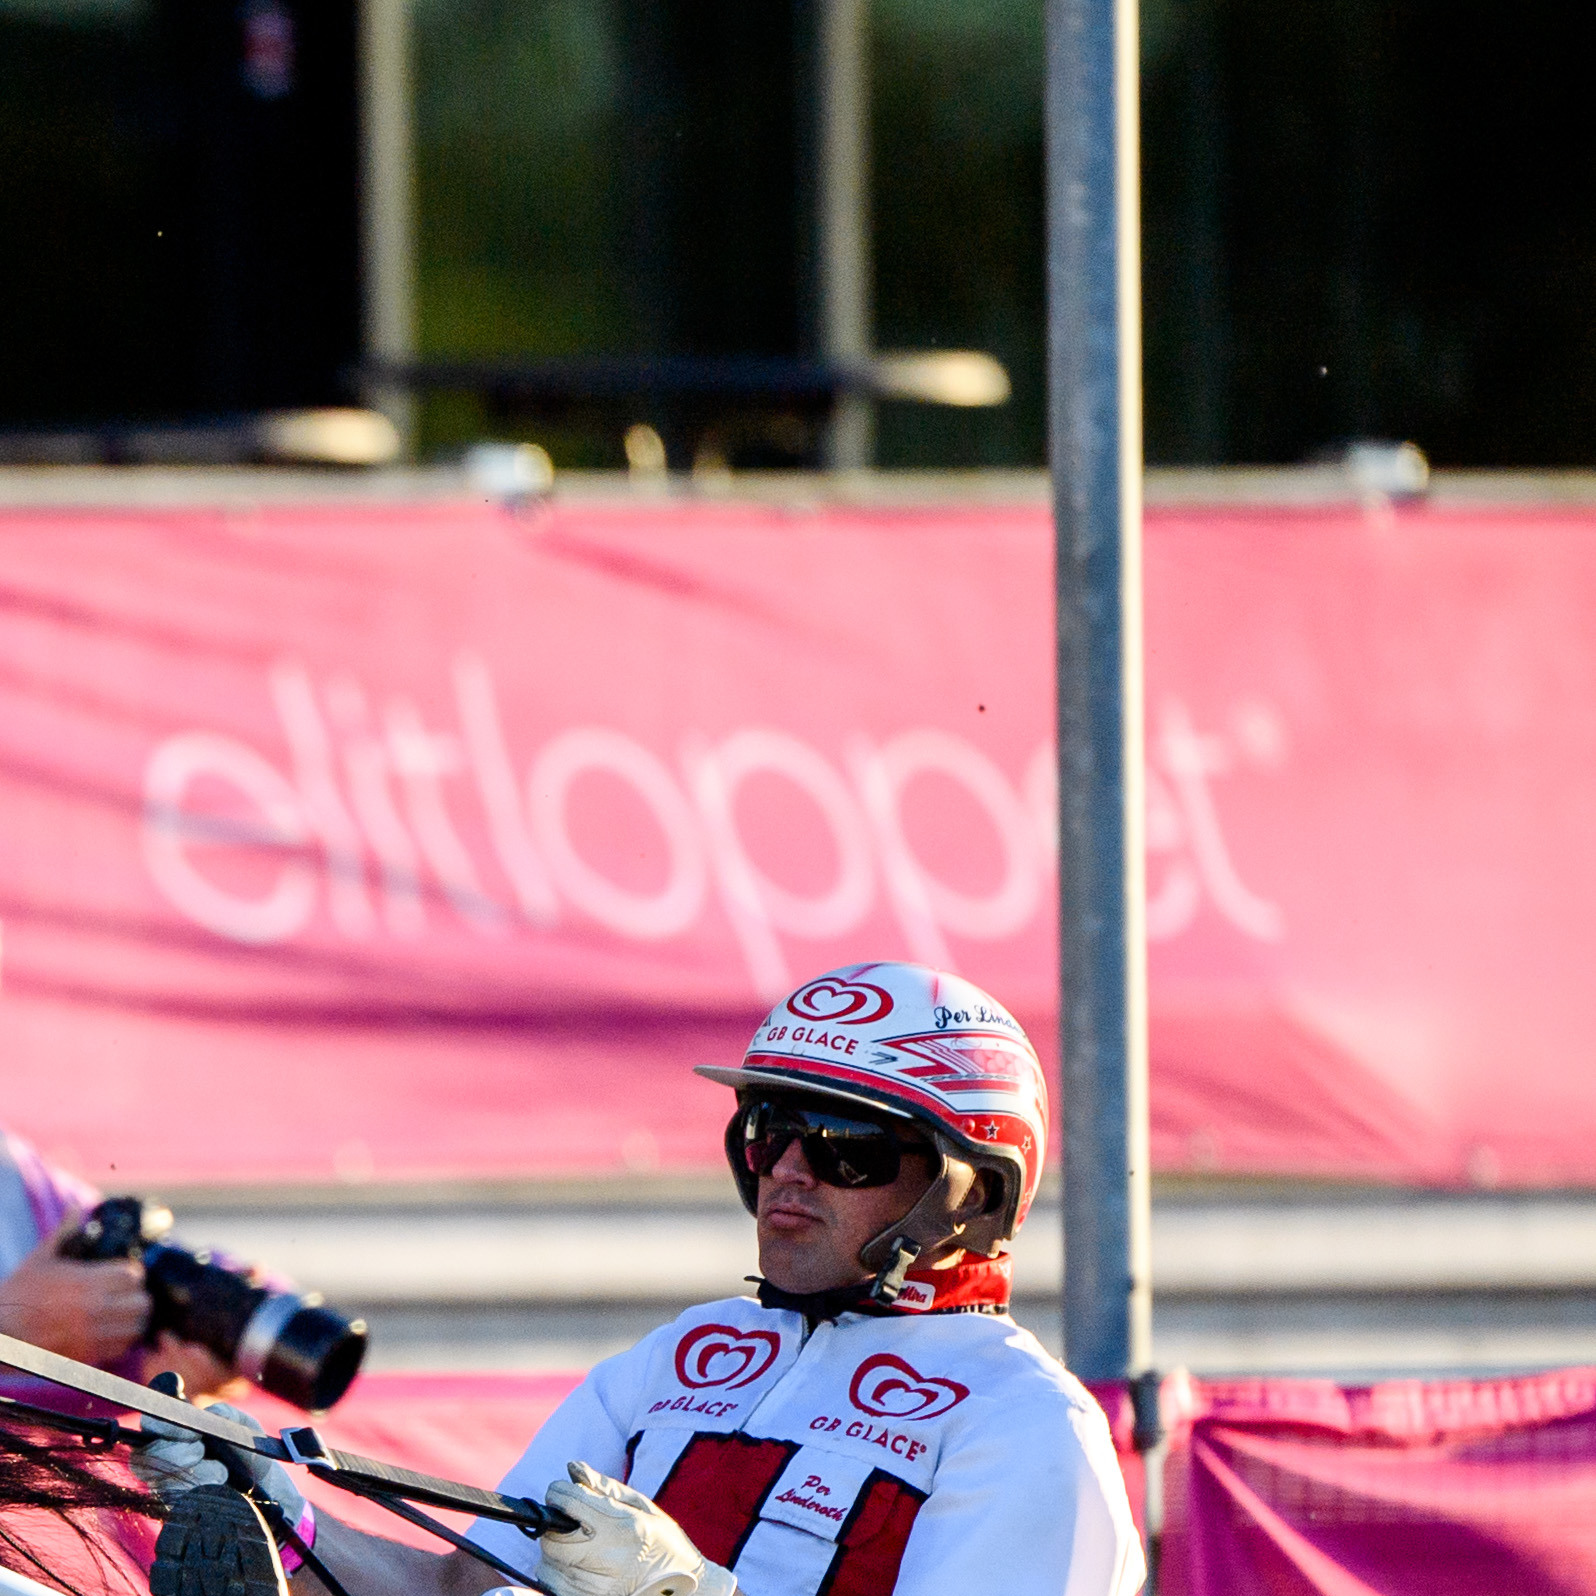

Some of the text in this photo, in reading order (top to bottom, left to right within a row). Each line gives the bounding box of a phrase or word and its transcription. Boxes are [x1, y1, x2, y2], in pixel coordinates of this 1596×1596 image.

[933, 1004, 972, 1029] Per
[766, 1025, 788, 1042] GB
[791, 1026, 860, 1056] GLACE
[808, 1415, 842, 1432] GB
[800, 1475, 831, 1496] Per
